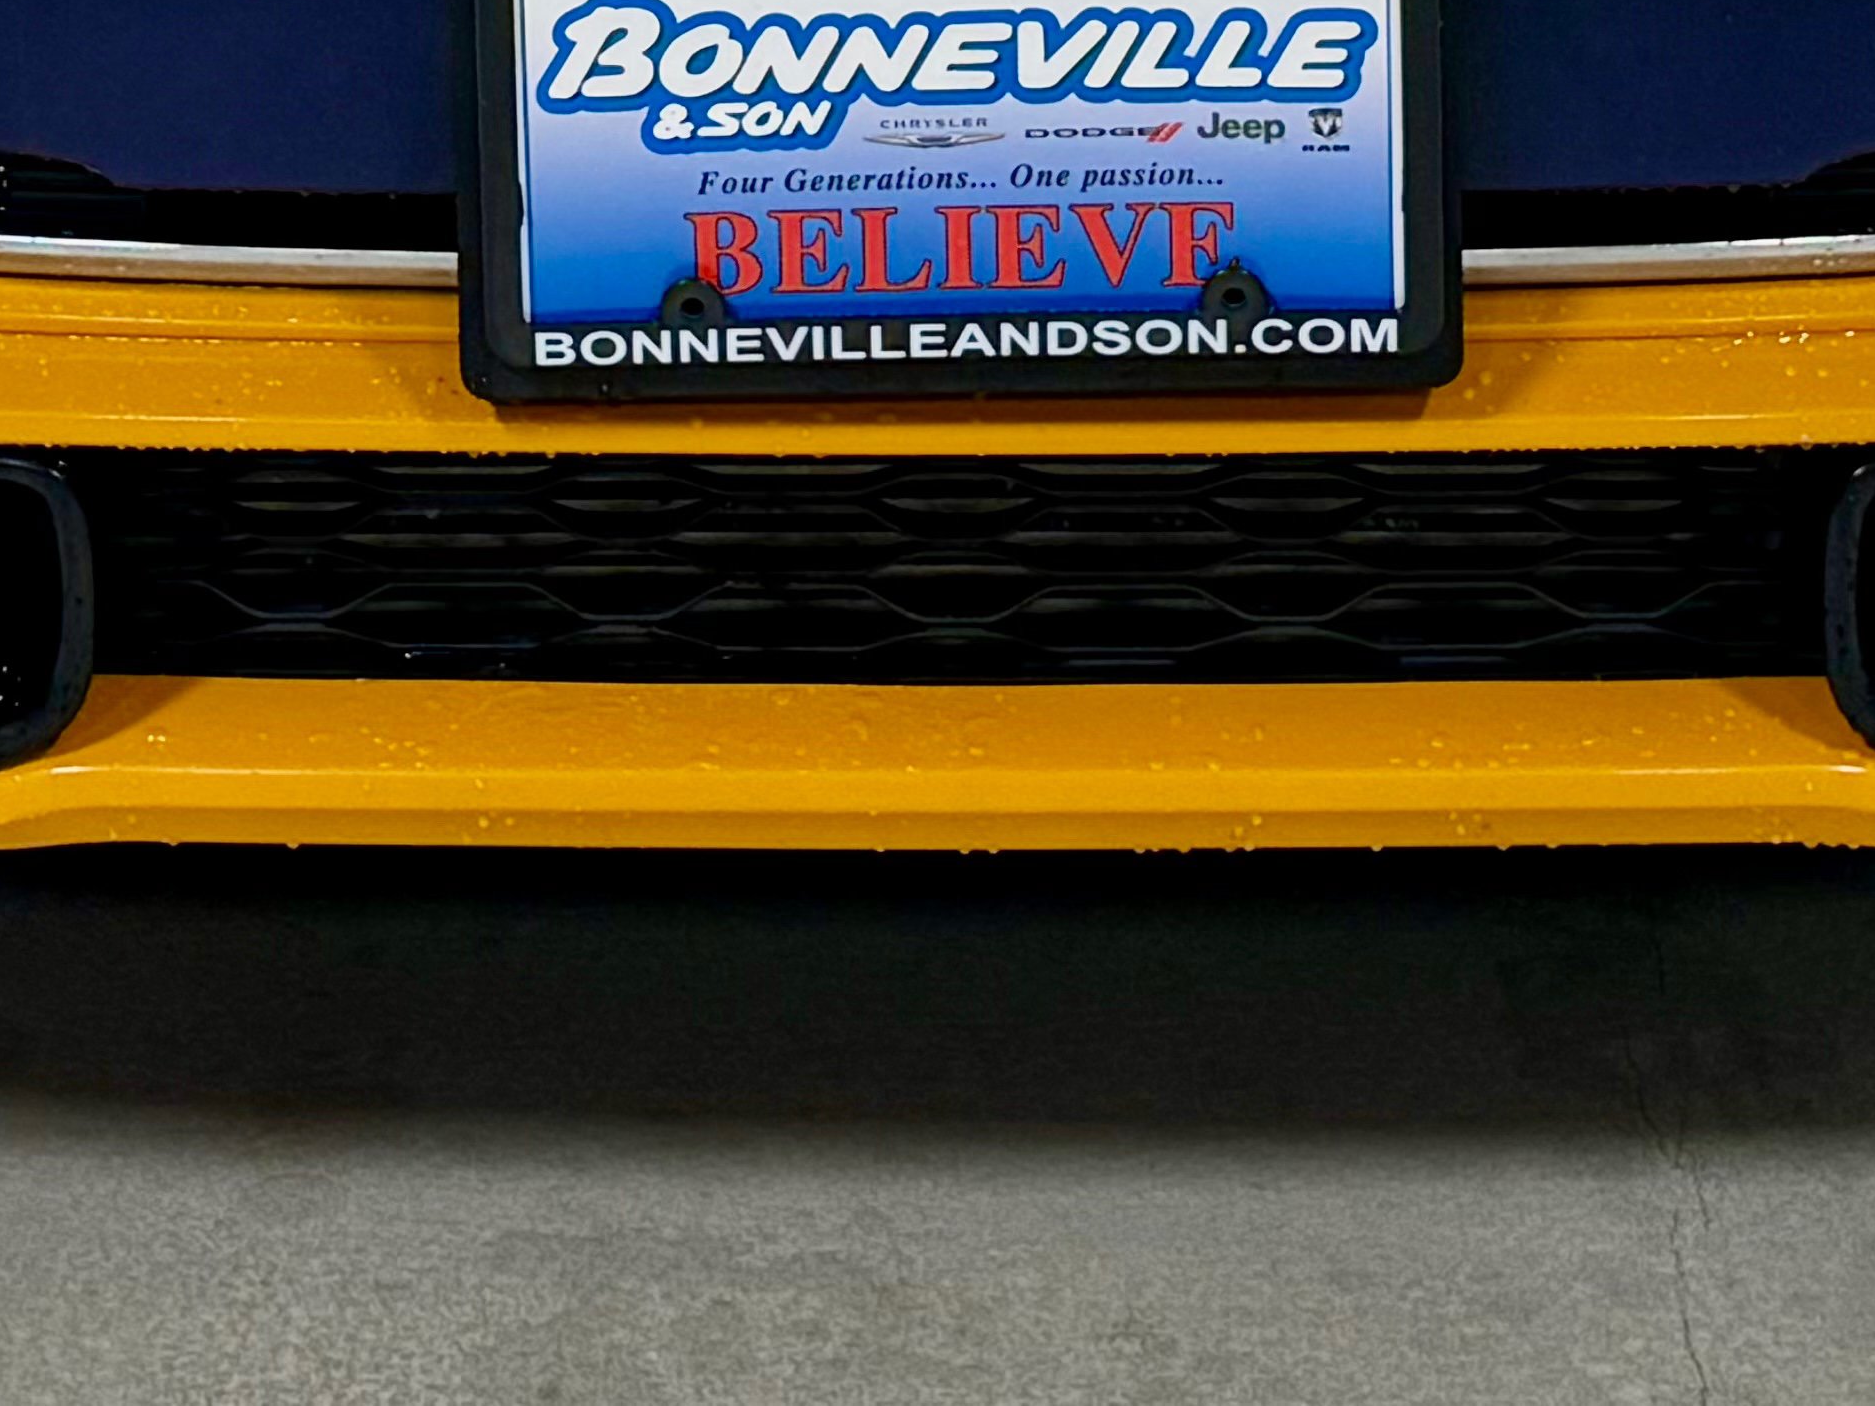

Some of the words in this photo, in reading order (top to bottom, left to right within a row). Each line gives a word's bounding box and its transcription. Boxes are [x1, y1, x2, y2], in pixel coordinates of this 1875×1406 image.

[547, 4, 1362, 98] BONNEVILLE
[880, 117, 989, 130] CHRYSLER
[1197, 112, 1287, 144] Jeep
[697, 170, 774, 196] Four
[784, 165, 997, 193] Generations...
[1009, 163, 1071, 188] One
[1080, 162, 1224, 193] passion...
[683, 200, 1235, 297] BELIEVE
[533, 317, 1399, 367] BONNEVILLEANDSON.COM
